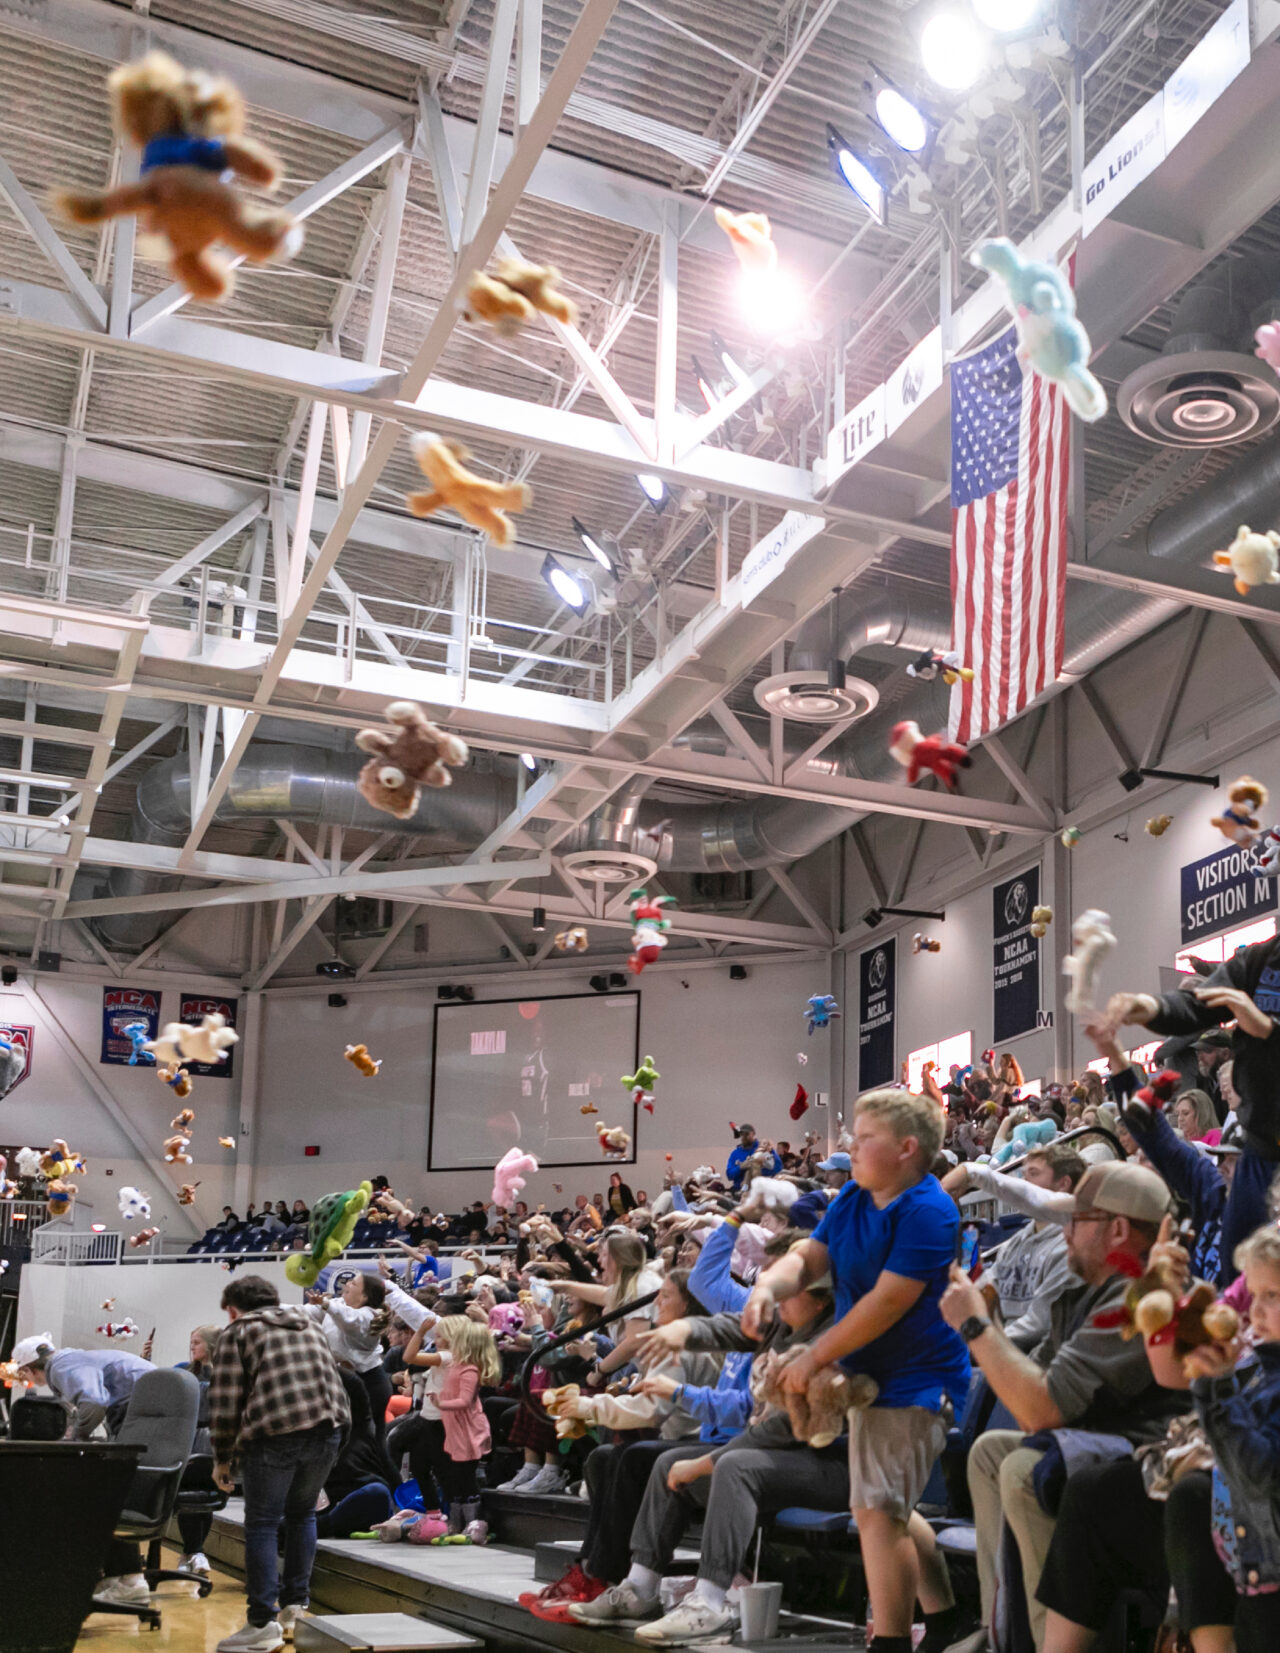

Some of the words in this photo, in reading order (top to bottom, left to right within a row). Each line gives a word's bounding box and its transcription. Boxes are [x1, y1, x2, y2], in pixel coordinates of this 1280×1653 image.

[1086, 178, 1106, 206] Go
[843, 409, 876, 465] Lite
[1196, 844, 1259, 891] VISITORS
[1187, 882, 1247, 931] SECTION
[1254, 876, 1271, 905] M
[1003, 938, 1028, 961] NCAA
[994, 950, 1037, 977] TOURNAMENT
[105, 990, 156, 1010] NCA
[182, 1001, 234, 1019] NCA
[1037, 1011, 1054, 1028] M
[816, 1092, 827, 1106] L
